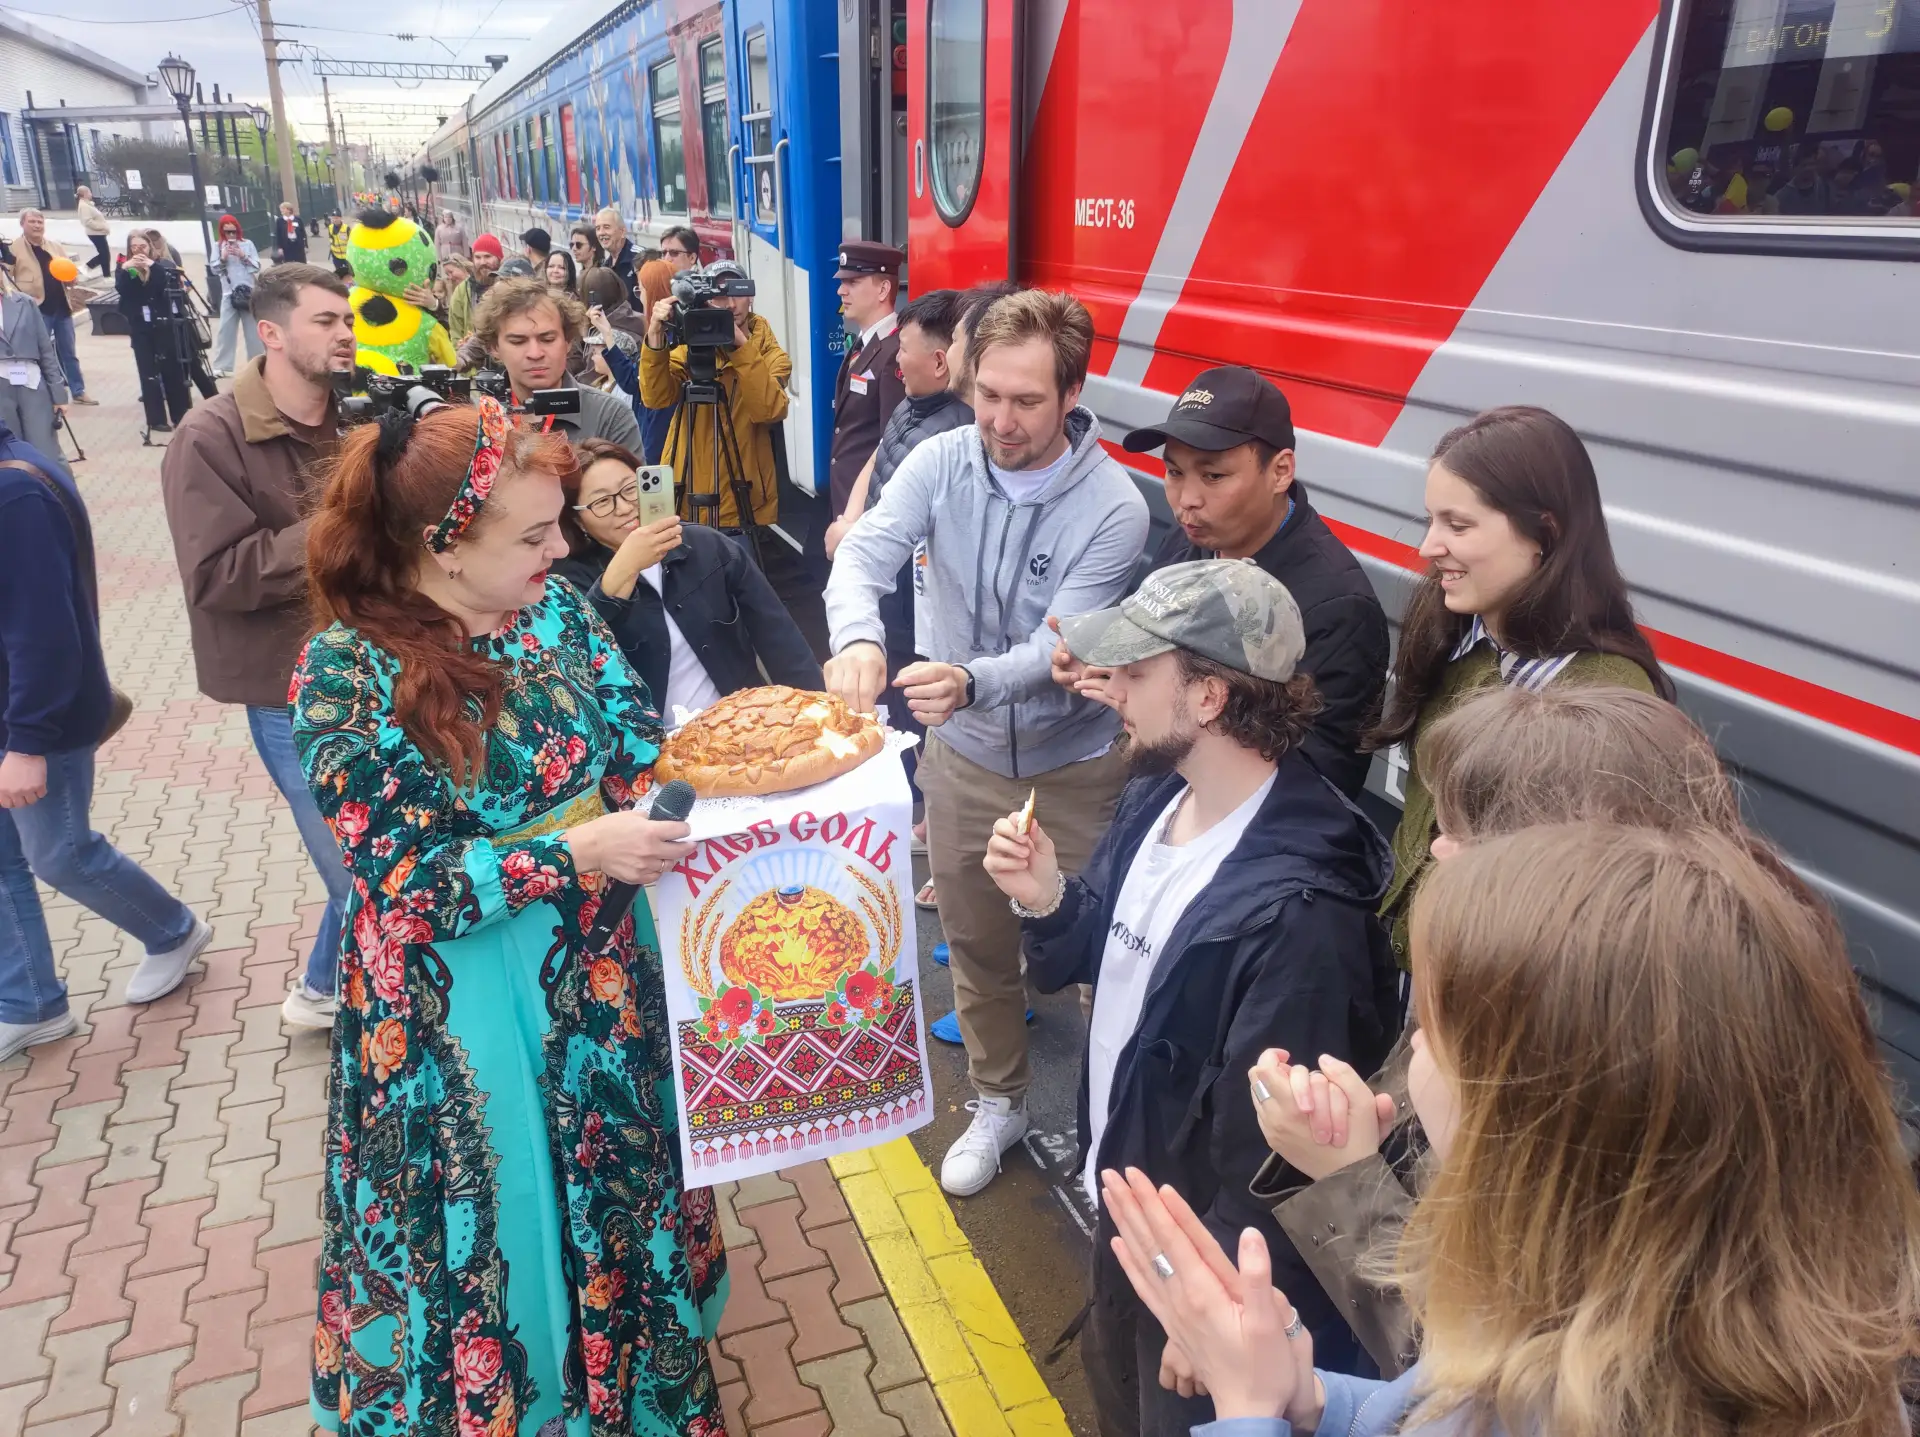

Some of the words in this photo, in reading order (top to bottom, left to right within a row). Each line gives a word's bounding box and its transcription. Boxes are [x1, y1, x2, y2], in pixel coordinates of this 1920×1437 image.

[1745, 21, 1834, 53] ВАГОН
[1074, 197, 1135, 230] МЕСТ-36
[672, 818, 781, 899] ХЛЕБ
[789, 811, 898, 874] СОЛЬ
